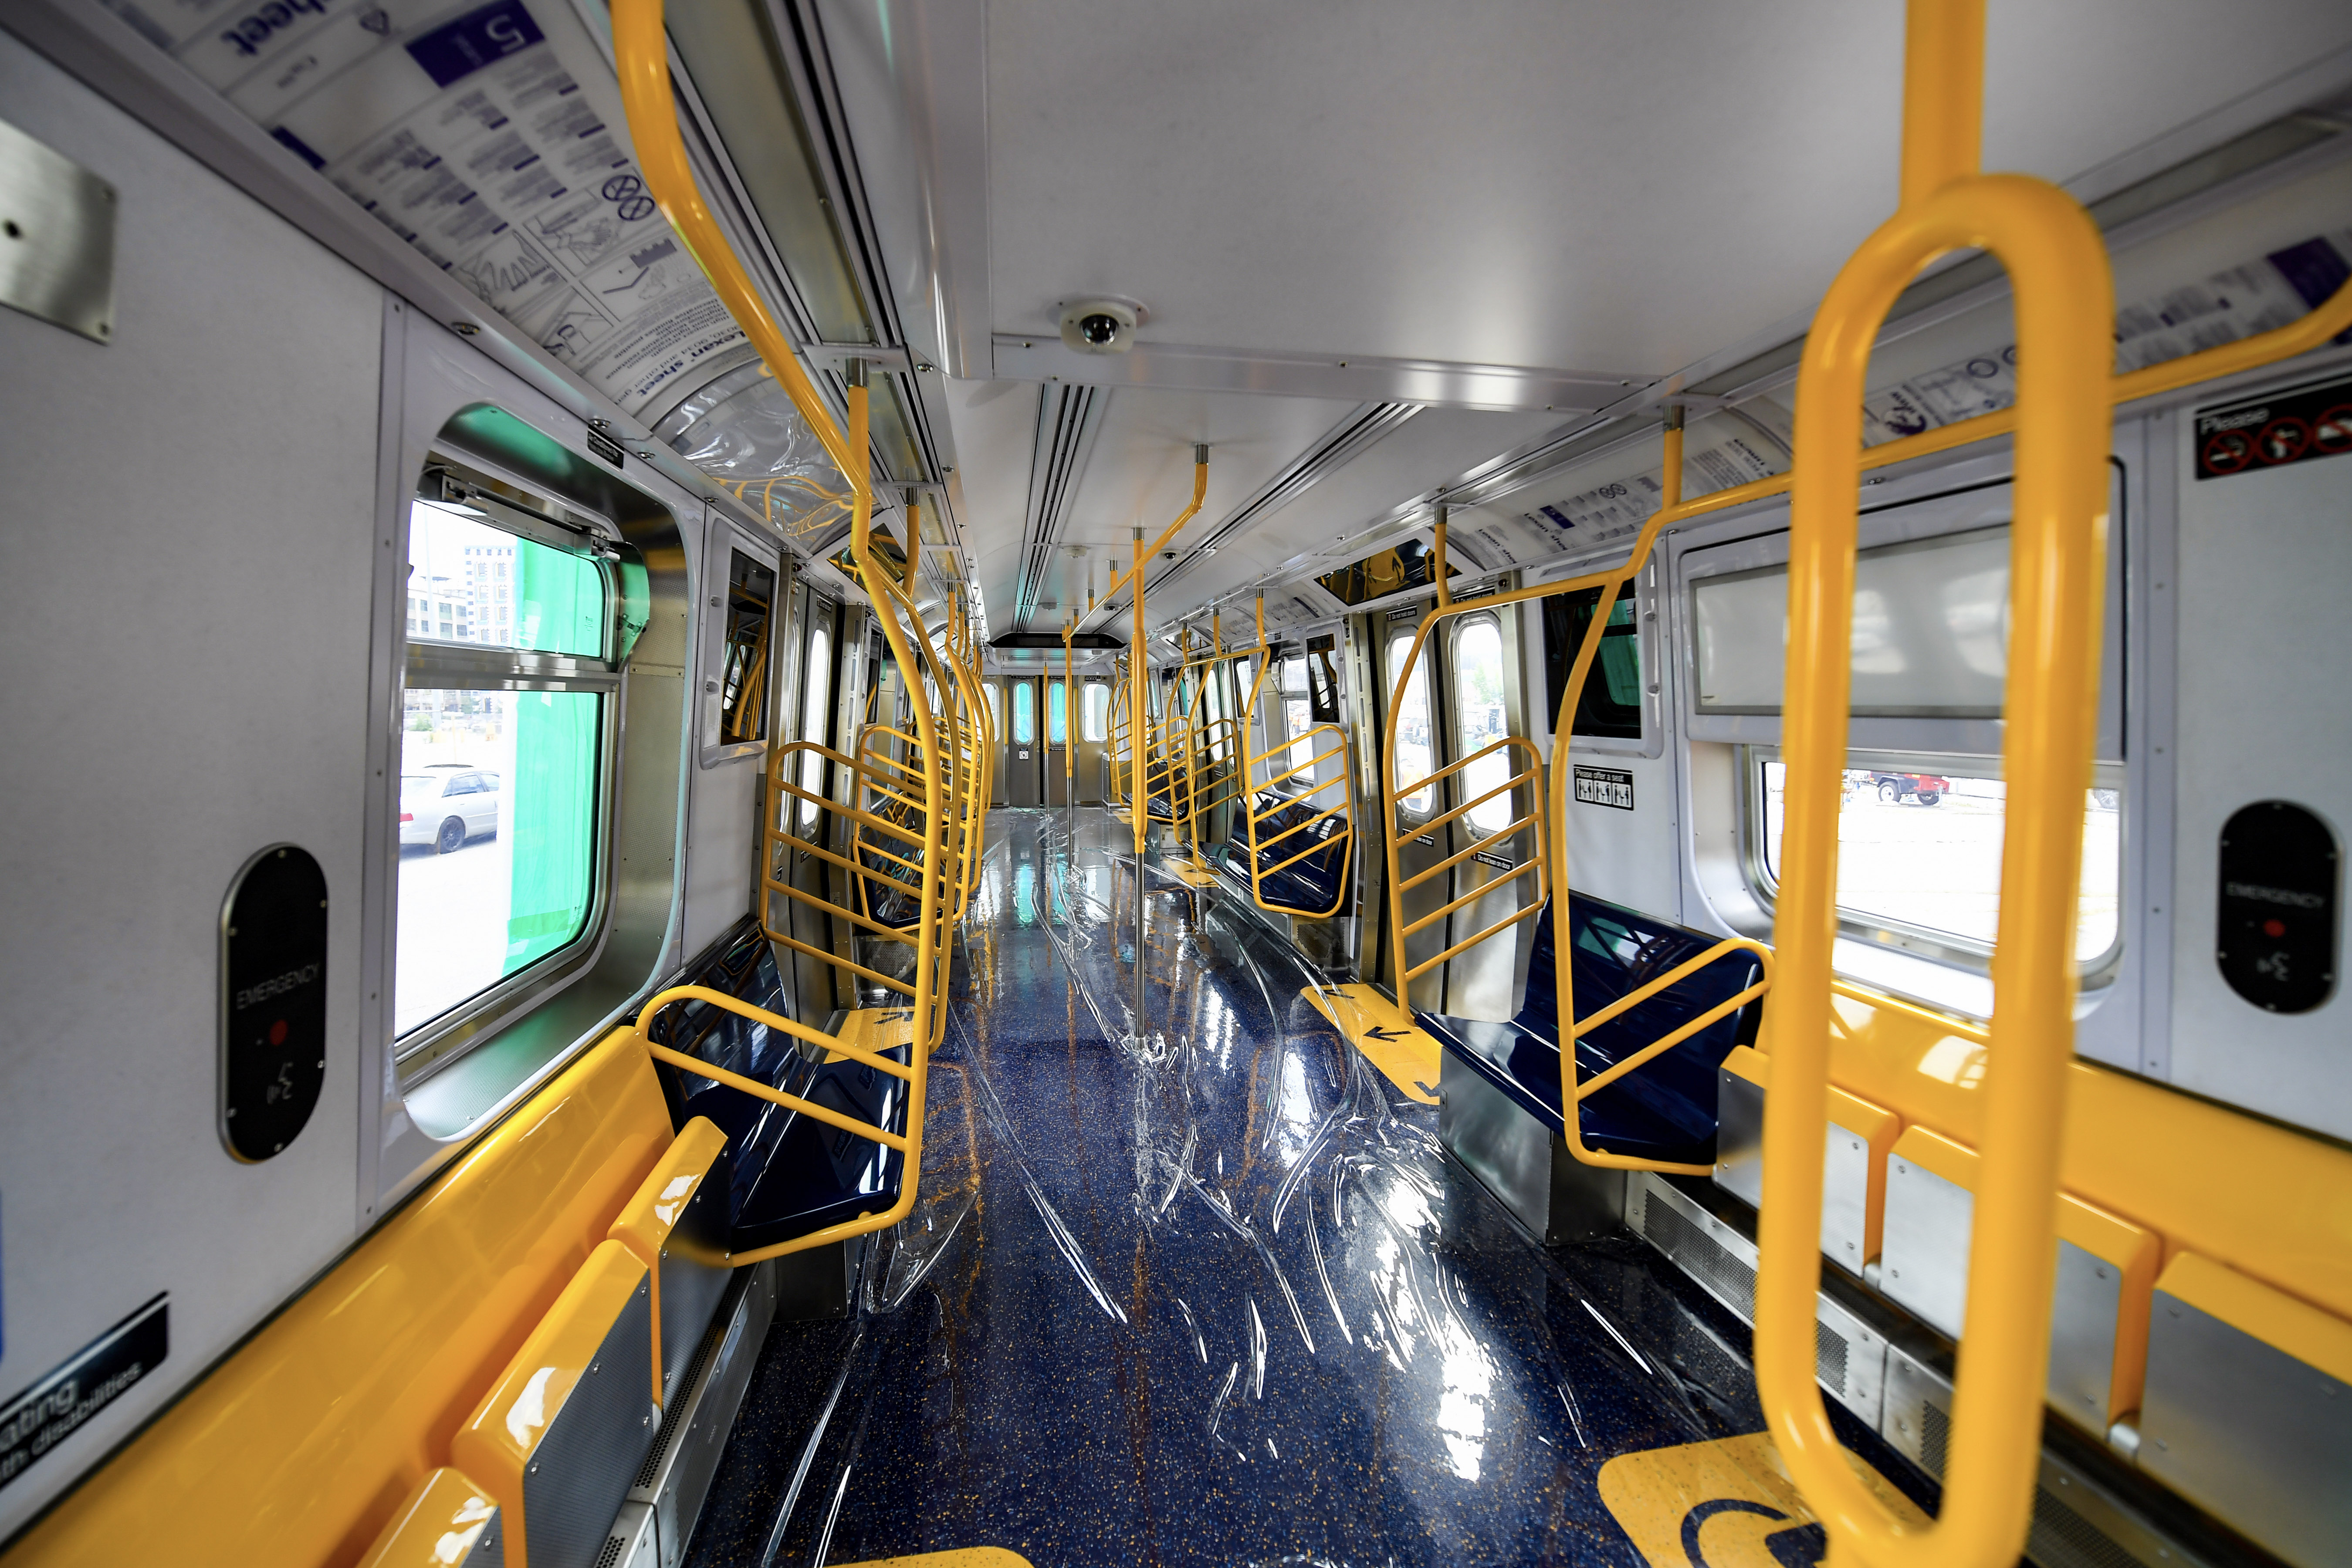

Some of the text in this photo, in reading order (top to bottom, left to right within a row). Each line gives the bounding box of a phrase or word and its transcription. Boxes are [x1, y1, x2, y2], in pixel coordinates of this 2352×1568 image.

[485, 14, 526, 53] 5
[613, 336, 643, 359] possible
[640, 323, 687, 352] temperature
[650, 337, 681, 358] strength
[660, 354, 678, 368] and
[634, 368, 658, 387] other
[636, 359, 684, 397] sheet
[2200, 408, 2270, 435] Please
[1575, 769, 1593, 778] Please
[1593, 771, 1606, 780] offer
[2226, 881, 2325, 909] EMERGENCY
[237, 962, 320, 1010] EMERGENCY
[30, 1361, 143, 1456] disabilities
